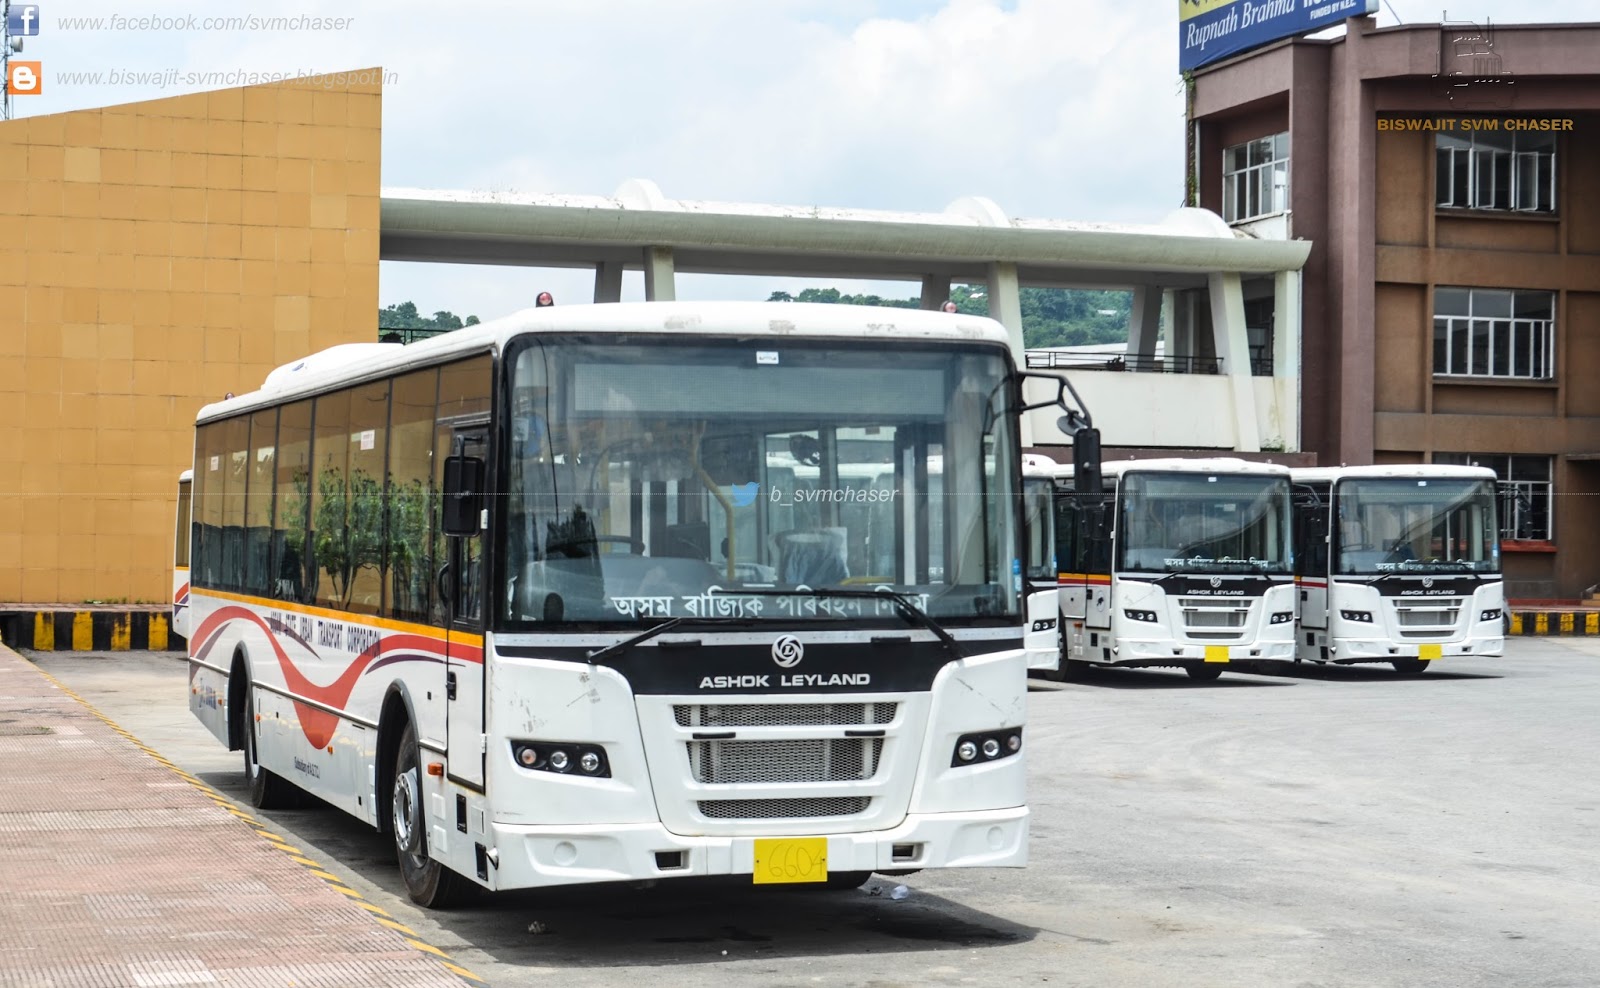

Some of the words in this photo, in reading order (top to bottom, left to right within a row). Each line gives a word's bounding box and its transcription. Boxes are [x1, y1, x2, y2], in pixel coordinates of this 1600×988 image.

[1185, 14, 1239, 50] Rupnath
[1241, 0, 1295, 29] Brahma
[1310, 5, 1332, 20] FUNDED
[1331, 2, 1340, 14] BY
[609, 595, 675, 619] অসম
[318, 620, 343, 650] TRANSPORT
[347, 625, 381, 659] CORPORATION
[699, 675, 770, 689] ASHOK
[781, 673, 871, 687] LEYLAND
[768, 842, 825, 878] 6604
